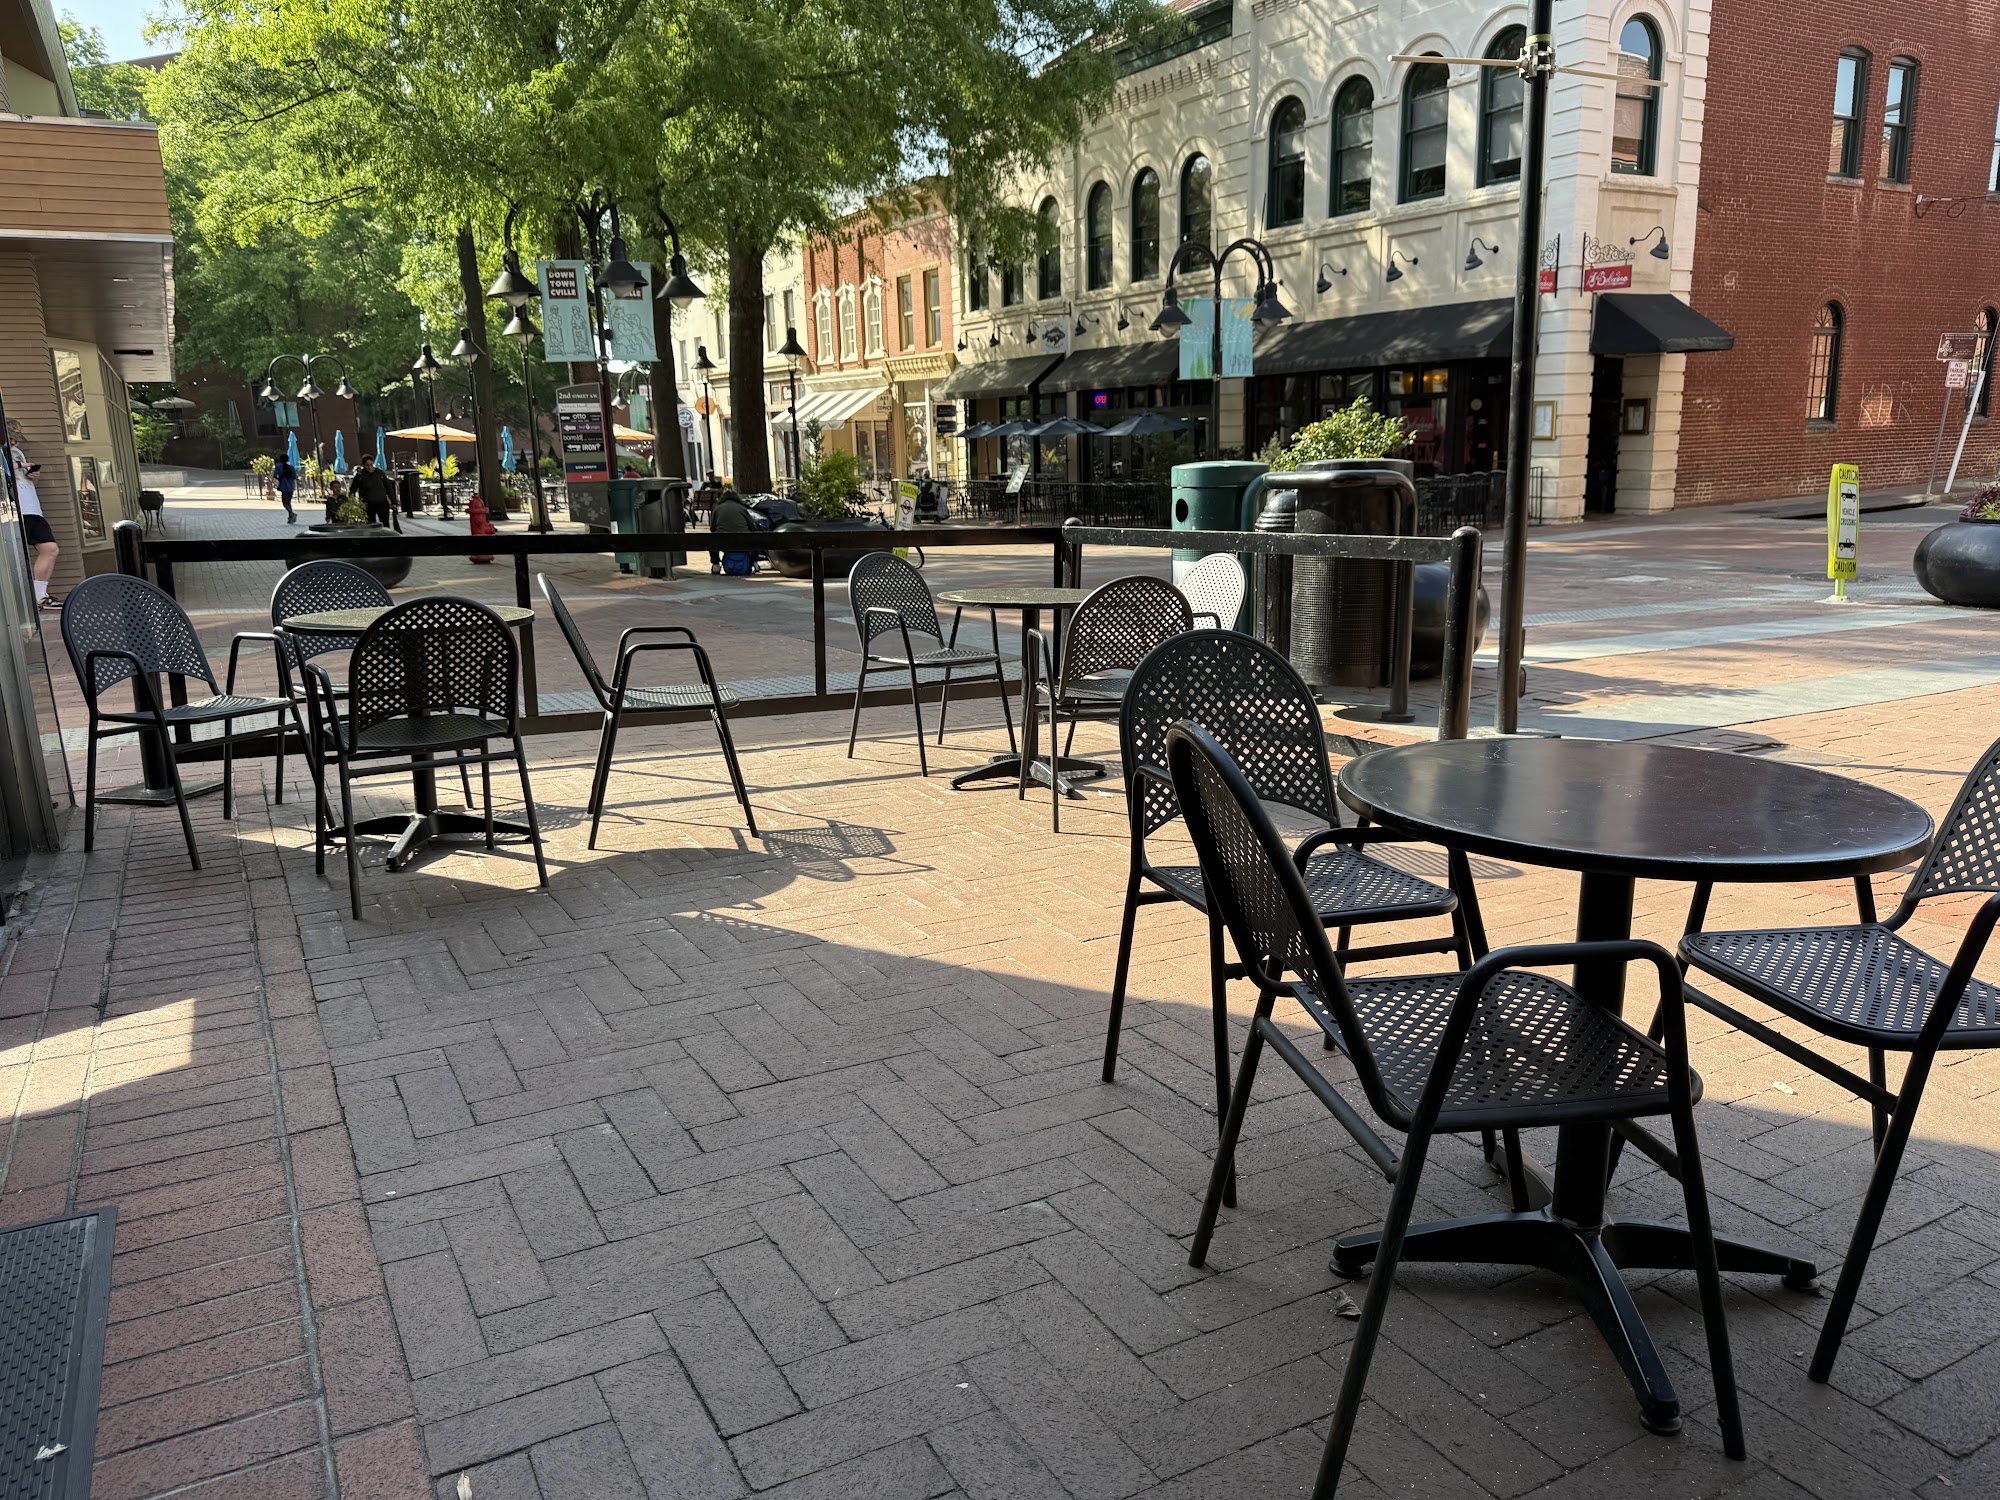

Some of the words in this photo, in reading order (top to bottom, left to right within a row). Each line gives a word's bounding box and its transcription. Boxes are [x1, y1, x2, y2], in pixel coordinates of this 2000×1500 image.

[548, 271, 574, 279] DOWN
[549, 280, 575, 288] TOWN
[550, 288, 576, 296] CVILLE
[1839, 468, 1858, 480] CAUTION
[901, 484, 917, 496] CAUTION
[1842, 508, 1855, 516] VEHICLE
[1841, 518, 1856, 526] CROSSING
[1834, 561, 1857, 573] CAUTION
